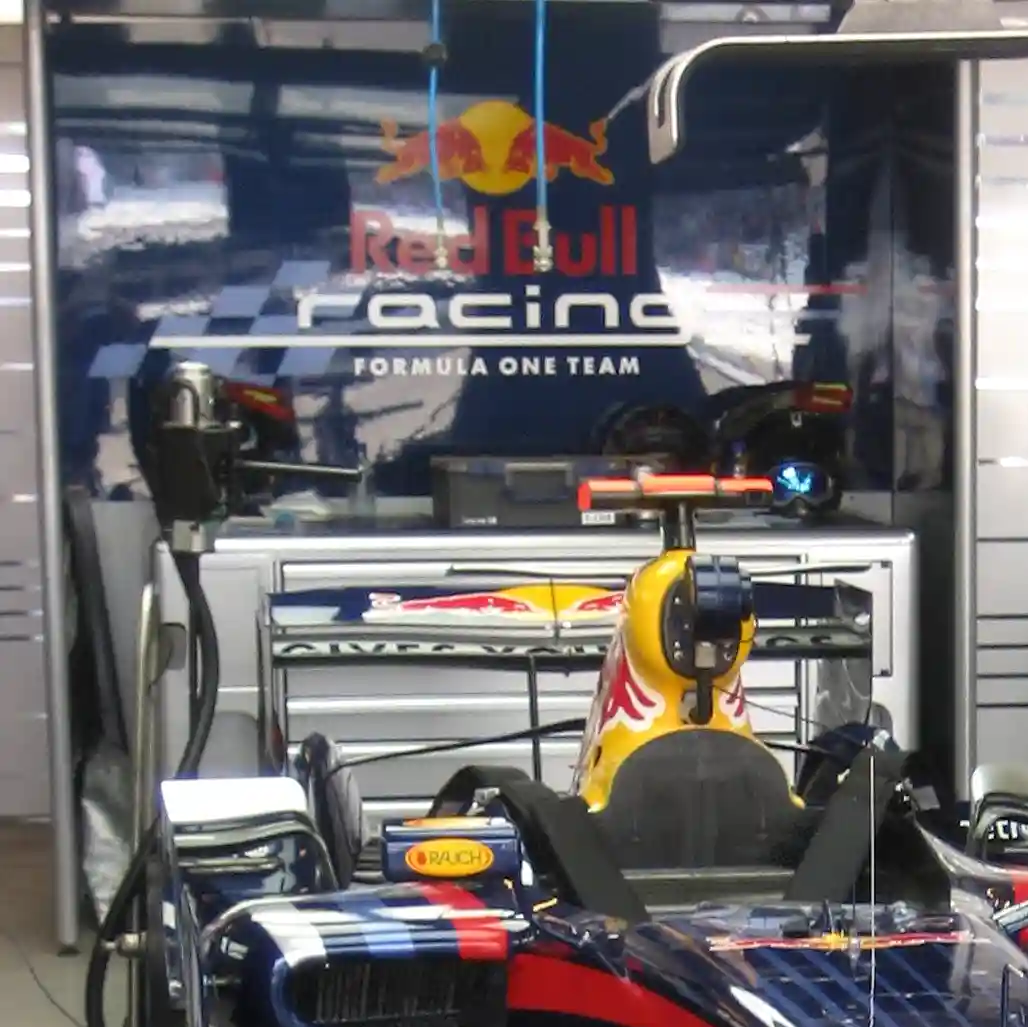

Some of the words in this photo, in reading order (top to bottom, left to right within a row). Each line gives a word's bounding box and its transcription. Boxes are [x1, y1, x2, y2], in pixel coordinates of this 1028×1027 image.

[350, 206, 488, 276] Red
[505, 206, 637, 276] Bull
[297, 285, 686, 344] racing
[354, 356, 488, 377] FORMULA
[498, 356, 557, 377] ONE
[566, 356, 641, 377] TEAM
[428, 849, 482, 866] RAUCH
